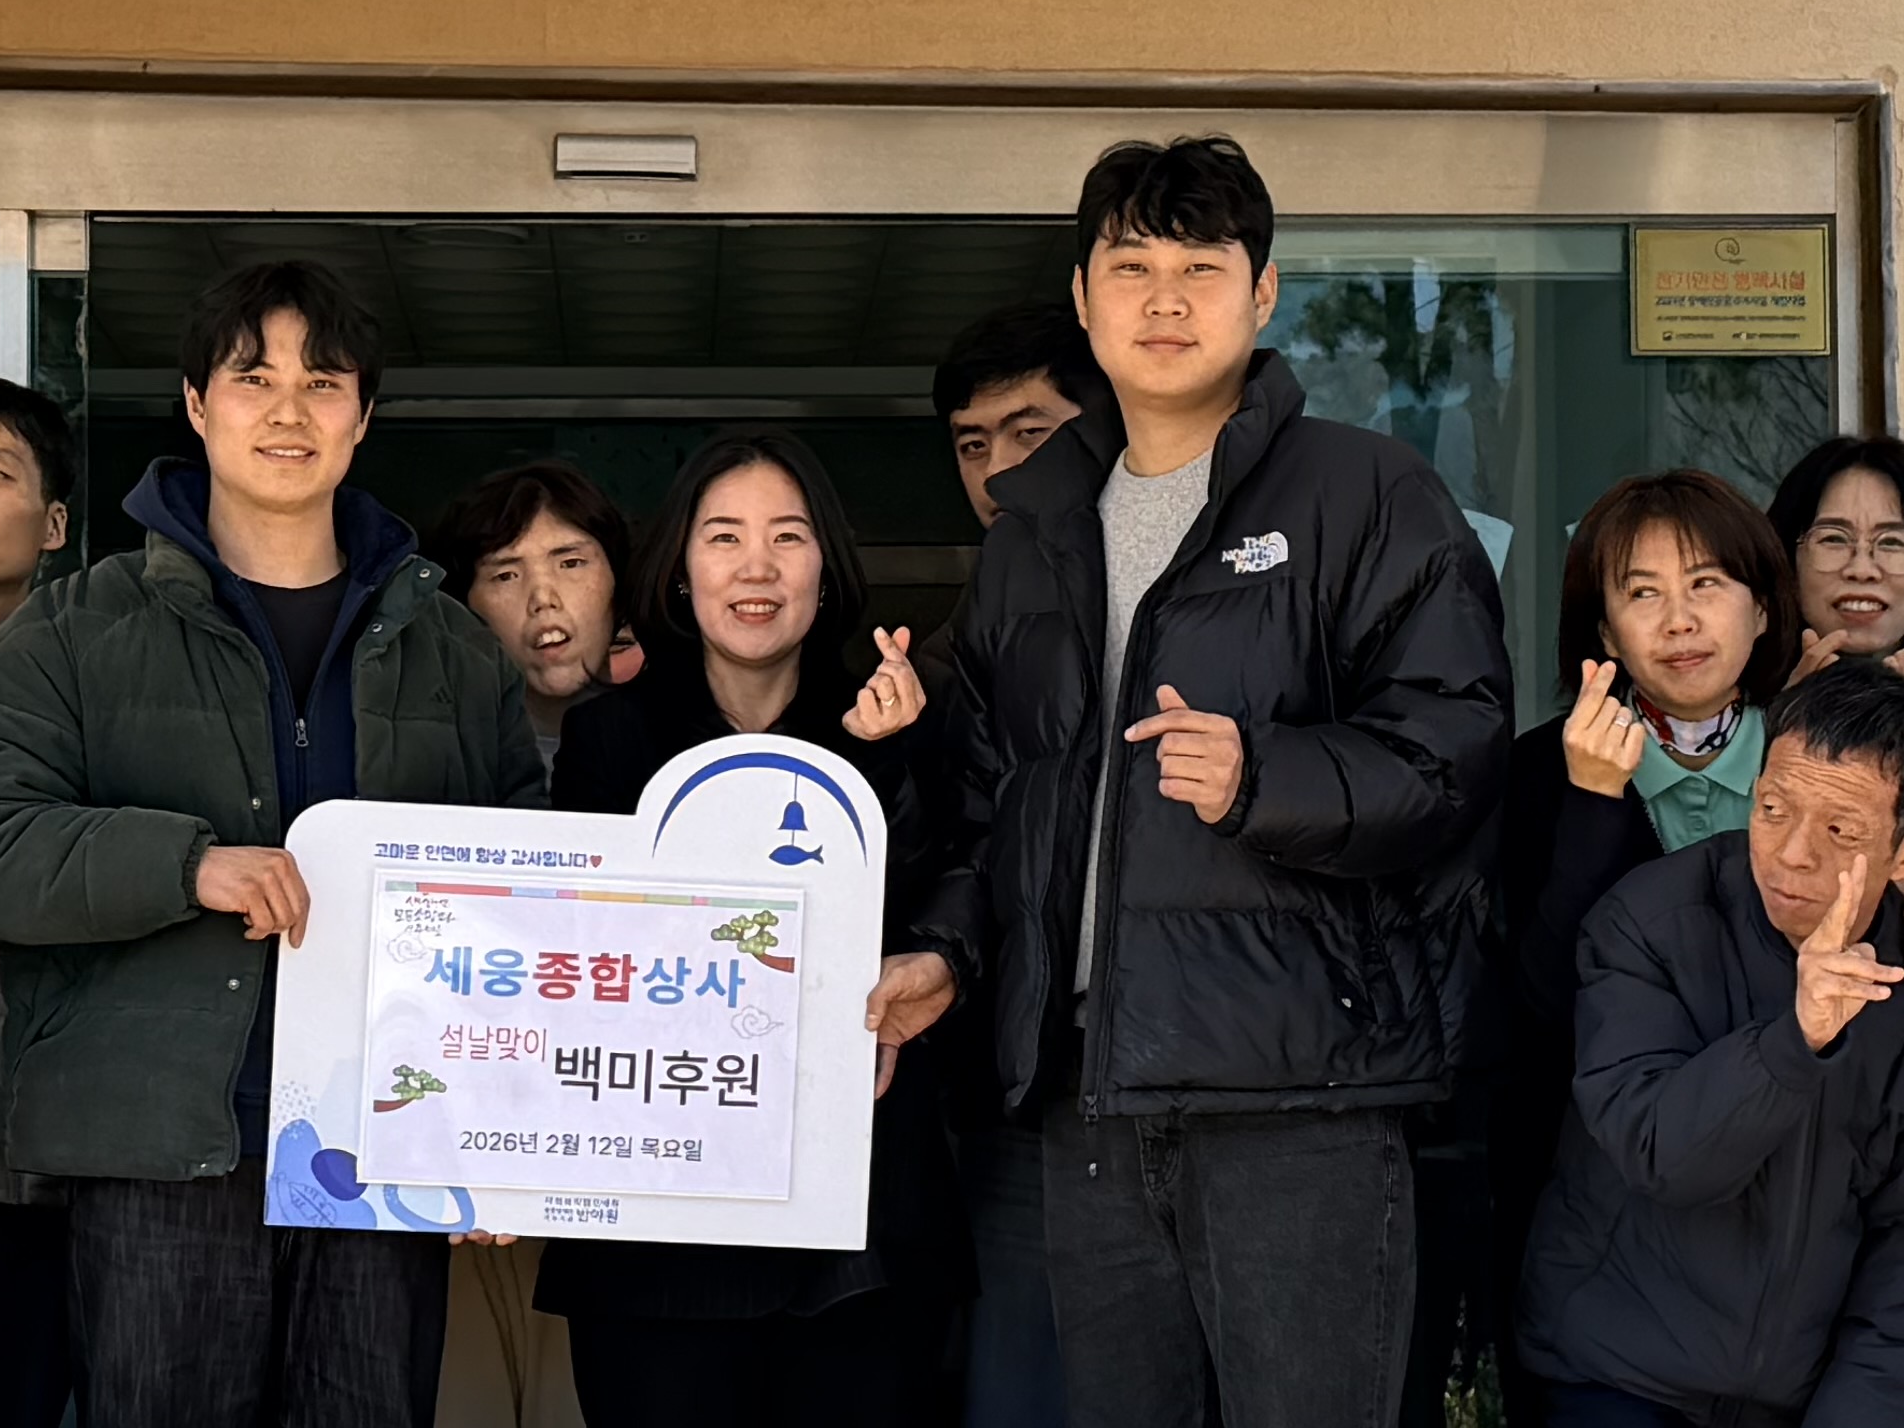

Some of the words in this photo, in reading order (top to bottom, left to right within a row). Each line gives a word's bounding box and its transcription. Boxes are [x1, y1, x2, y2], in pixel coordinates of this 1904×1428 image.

[374, 843, 419, 860] 고마운
[476, 847, 506, 865] 항상
[424, 946, 745, 1008] 세웅종합상사
[440, 1024, 547, 1062] 설날맞이
[555, 1046, 759, 1107] 백미후원
[459, 1131, 538, 1154] 2026년
[545, 1133, 580, 1156] 2월
[588, 1136, 633, 1158] 12일
[640, 1137, 703, 1162] 목요일
